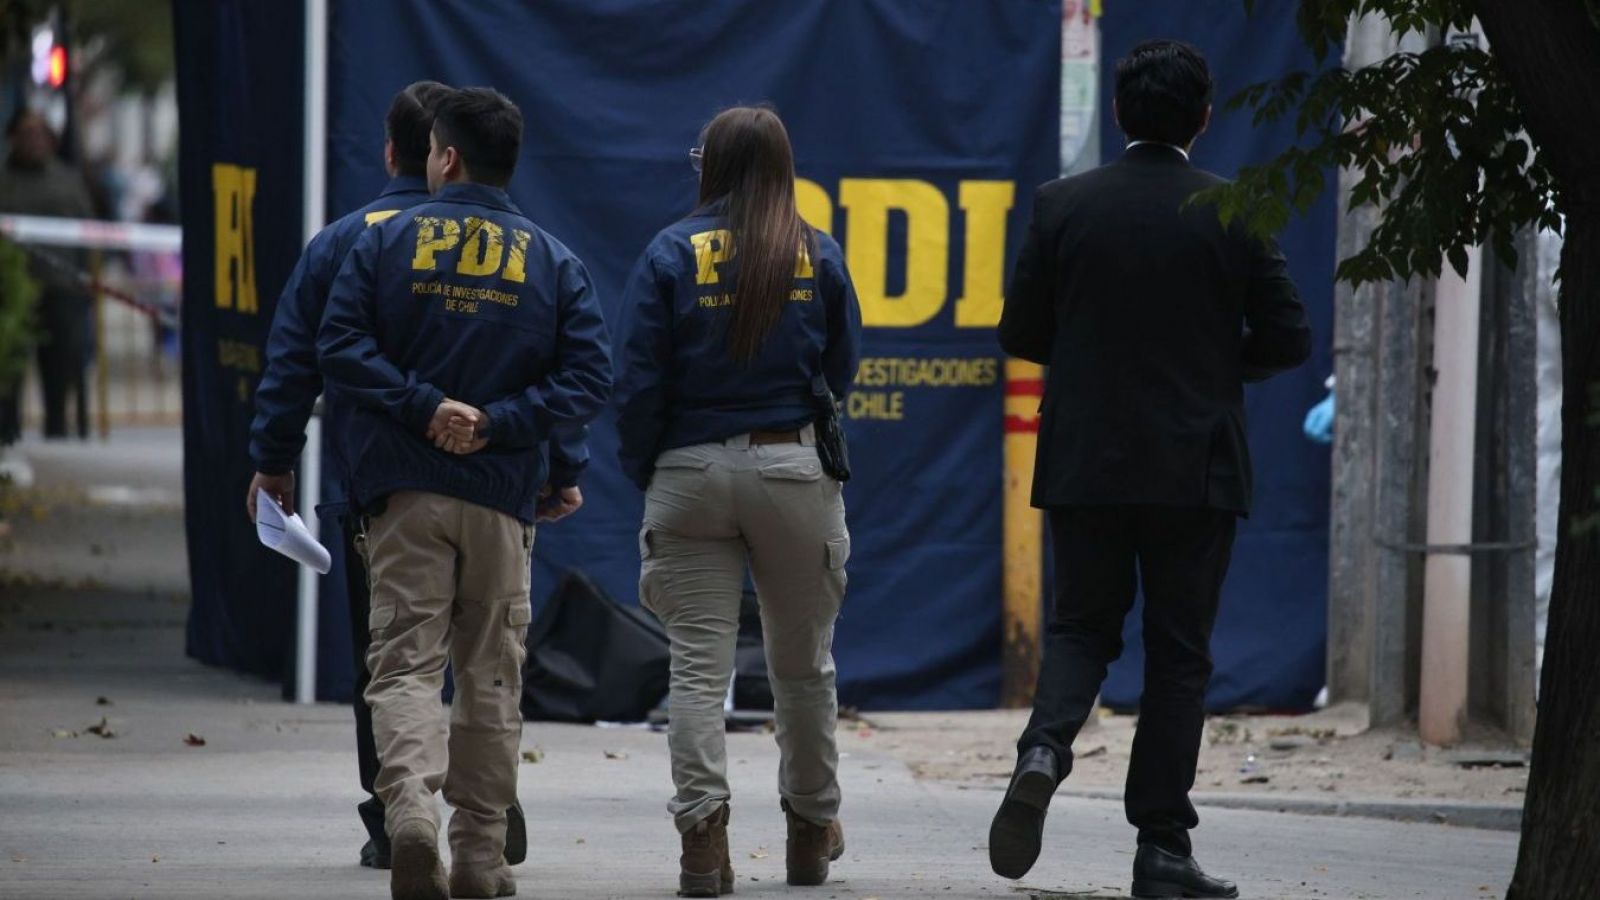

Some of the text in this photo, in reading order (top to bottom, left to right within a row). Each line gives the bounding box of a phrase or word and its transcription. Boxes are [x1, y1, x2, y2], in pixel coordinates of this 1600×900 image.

[411, 215, 531, 284] PDI
[690, 229, 814, 285] PI
[459, 300, 478, 312] CHILE
[847, 390, 905, 420] CHILE
